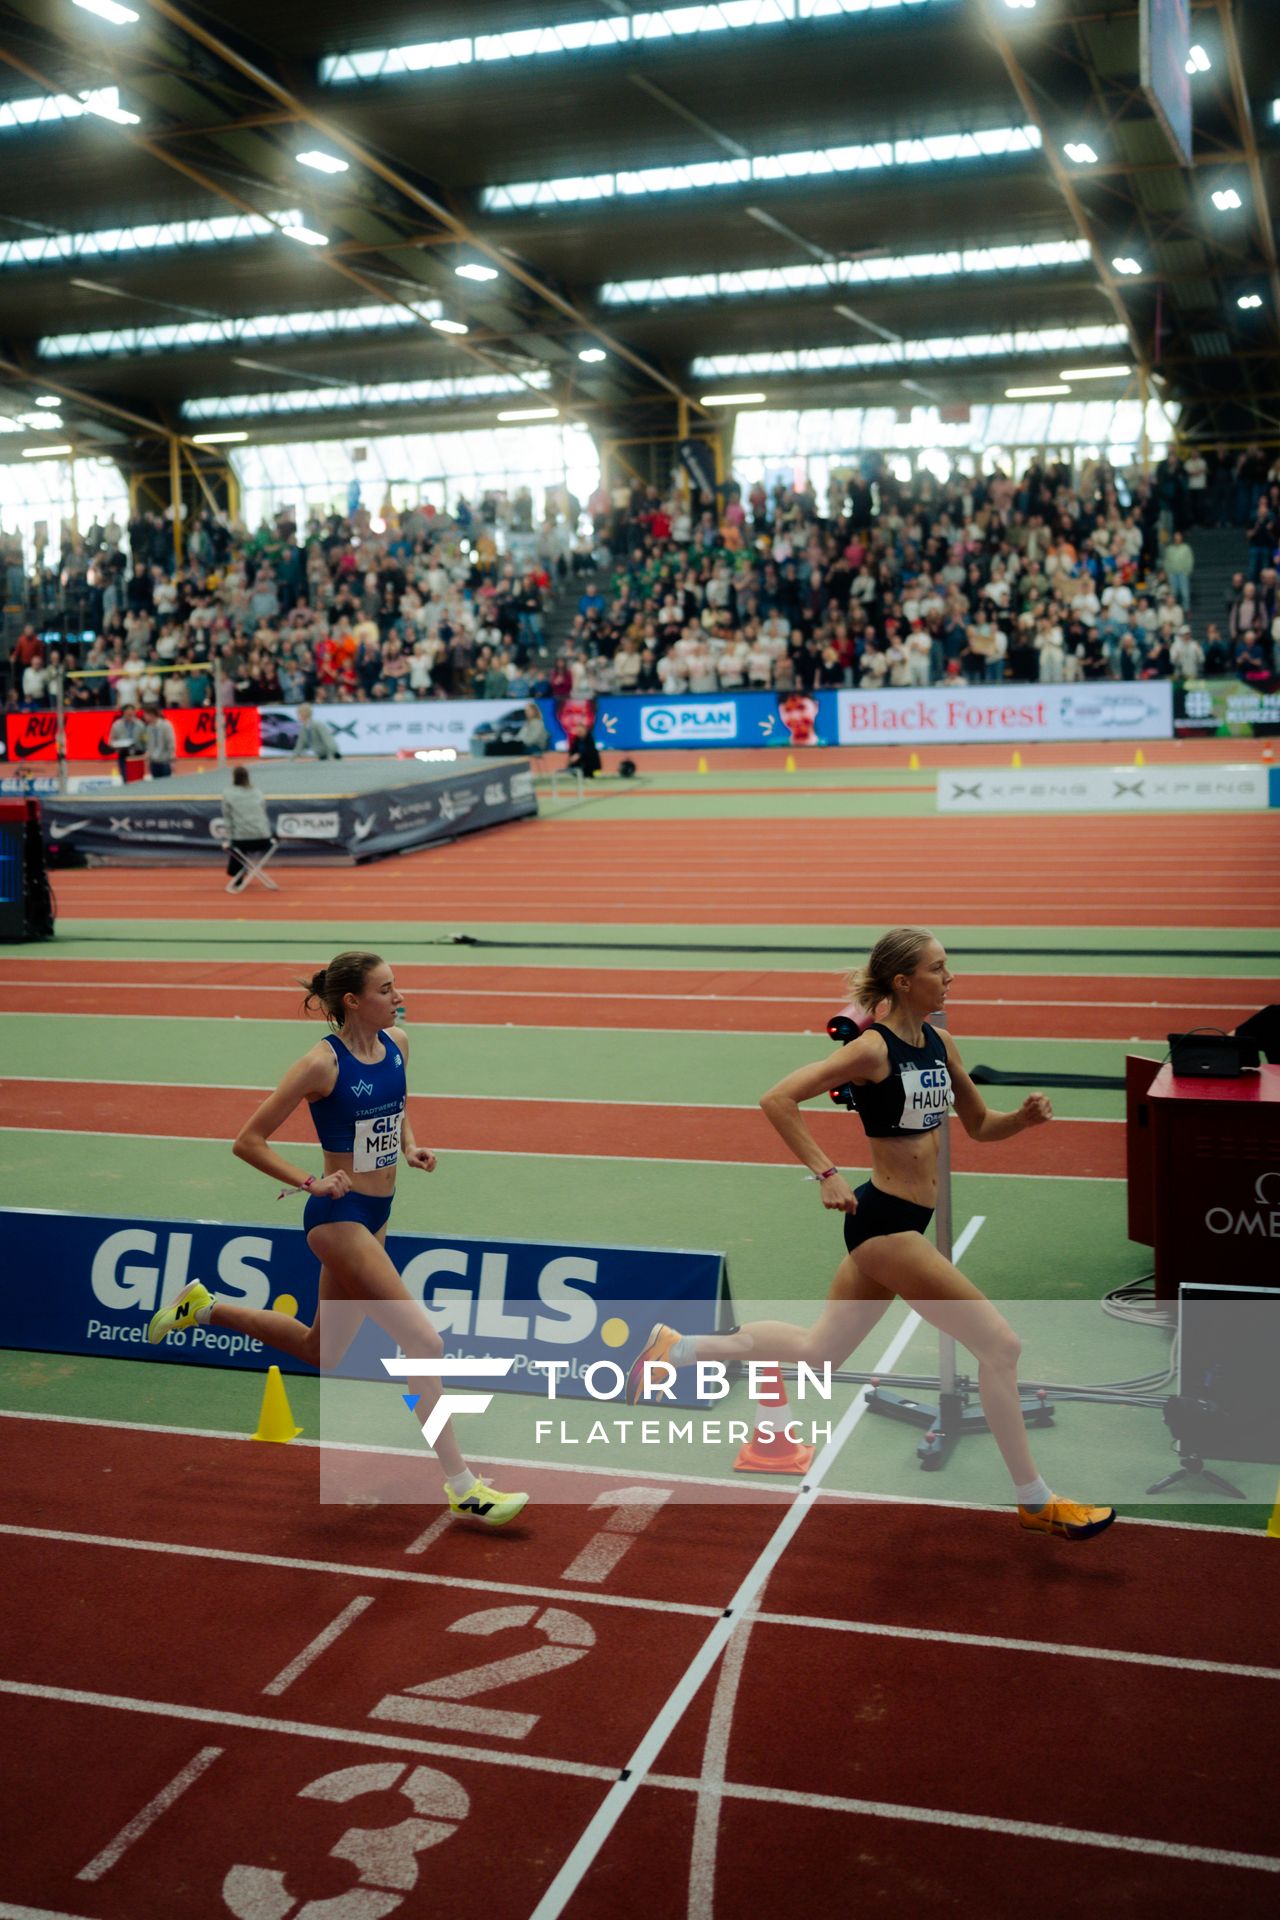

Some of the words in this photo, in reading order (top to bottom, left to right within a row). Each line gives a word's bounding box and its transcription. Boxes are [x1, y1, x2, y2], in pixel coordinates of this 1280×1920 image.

[681, 712, 731, 726] PLAN
[849, 701, 938, 730] Black
[946, 700, 1047, 728] Forest
[366, 721, 465, 735] XPENG
[990, 783, 1088, 798] XPENG
[1153, 779, 1256, 795] XPENG
[134, 818, 194, 830] XPENG
[920, 1070, 947, 1089] GLS
[366, 1131, 399, 1153] MEIS
[86, 1319, 153, 1343] Parcel
[192, 1329, 264, 1356] People
[367, 1605, 597, 1741] 2
[222, 1762, 471, 1920] 3
